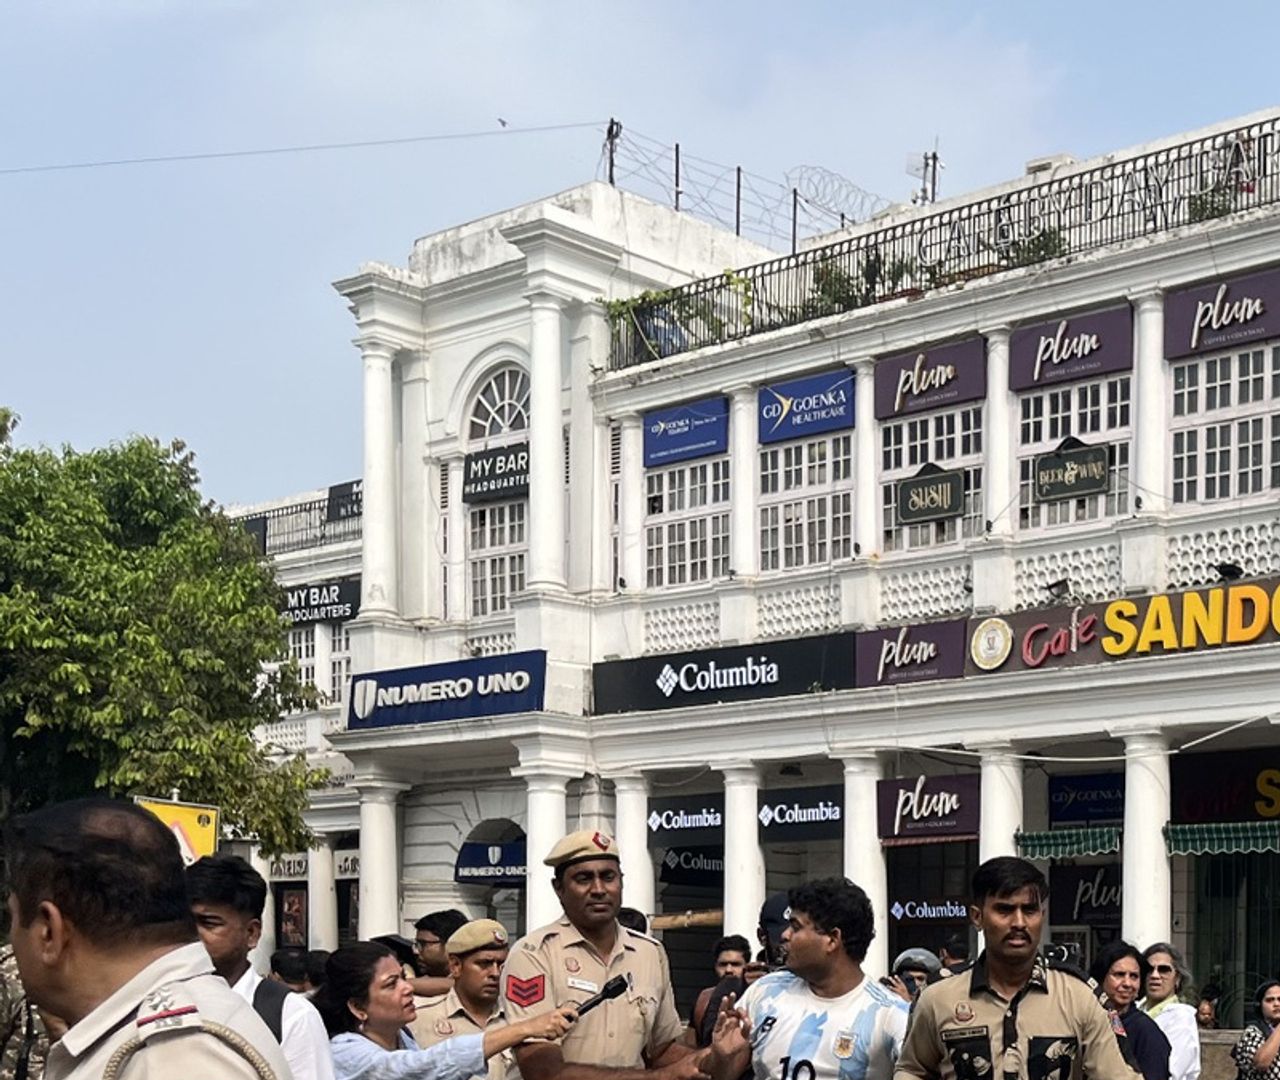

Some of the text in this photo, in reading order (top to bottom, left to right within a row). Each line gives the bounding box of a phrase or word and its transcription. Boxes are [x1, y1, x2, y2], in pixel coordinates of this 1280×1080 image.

[1191, 283, 1265, 349] plum
[1033, 319, 1102, 382] plum
[894, 352, 957, 413] plum
[763, 390, 847, 420] GD GOENKA
[792, 404, 847, 426] HEALTHCARE
[470, 452, 528, 479] MY BAR
[1039, 466, 1063, 486] BEER
[1063, 462, 1078, 486] &
[908, 481, 952, 512] SUSHI
[287, 584, 340, 609] MY BAR
[1021, 605, 1098, 667] Cafe
[876, 627, 937, 681] plum
[376, 670, 531, 708] NUMERO UNO
[677, 655, 779, 693] Columbia
[661, 808, 722, 830] Columbia
[773, 801, 841, 824] Columbia
[894, 774, 960, 836] plum
[679, 851, 725, 871] Colum
[904, 901, 967, 919] Columbia
